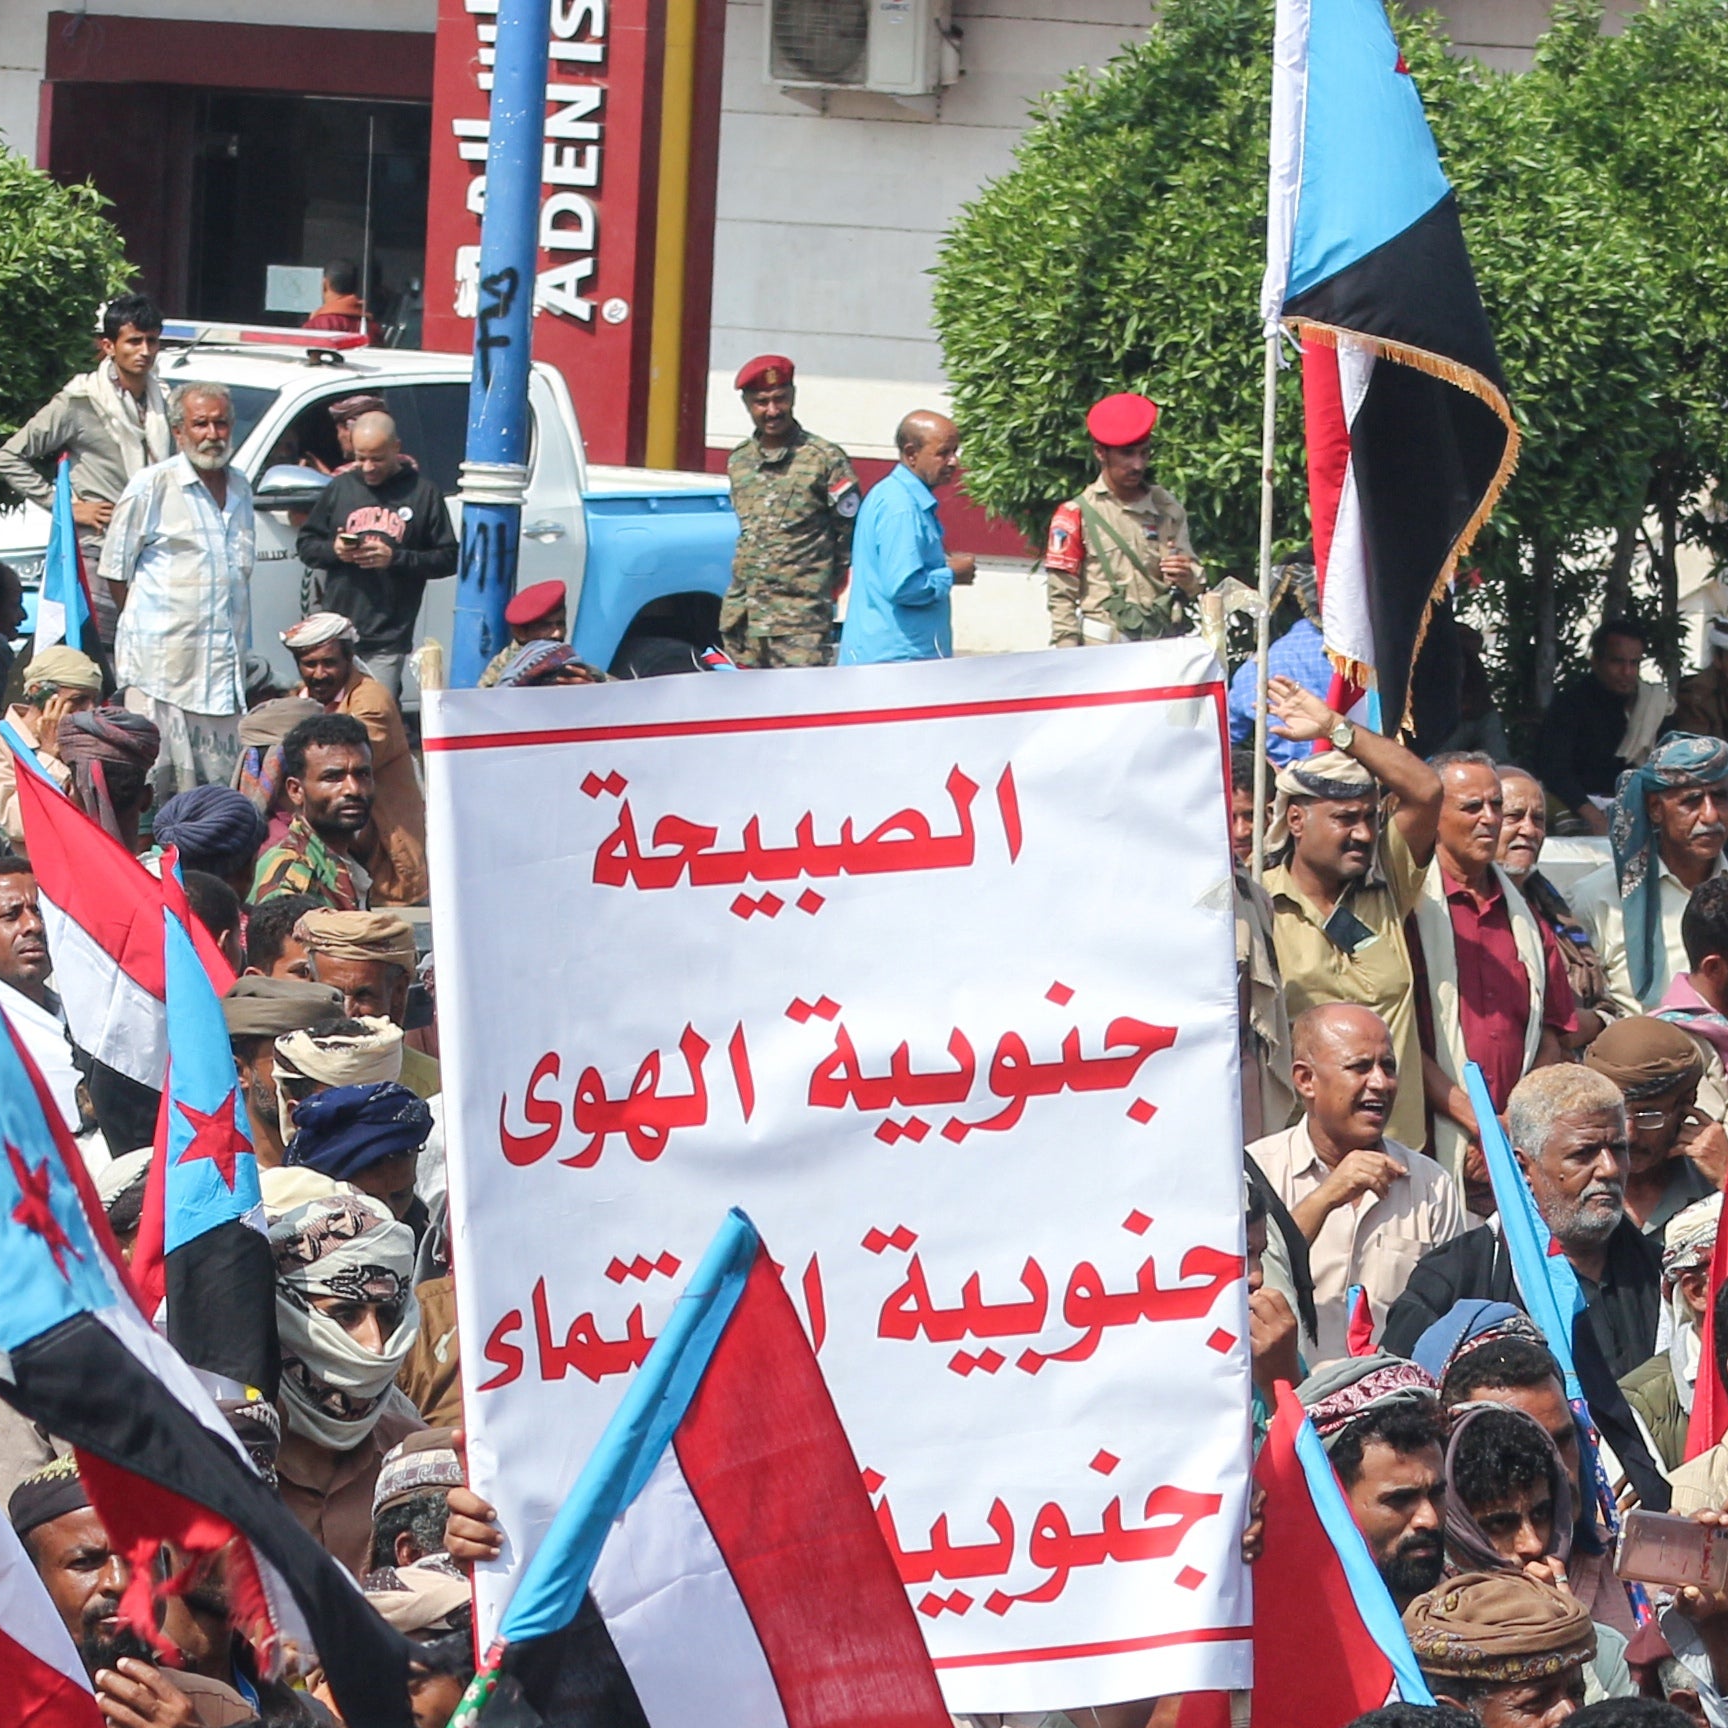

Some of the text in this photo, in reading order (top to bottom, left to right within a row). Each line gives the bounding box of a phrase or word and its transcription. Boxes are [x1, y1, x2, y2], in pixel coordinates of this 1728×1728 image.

[580, 763, 1023, 920] الصبيحة
[500, 980, 1178, 1170] جنوبية الهوى
[860, 1208, 1247, 1378] جنوبية
